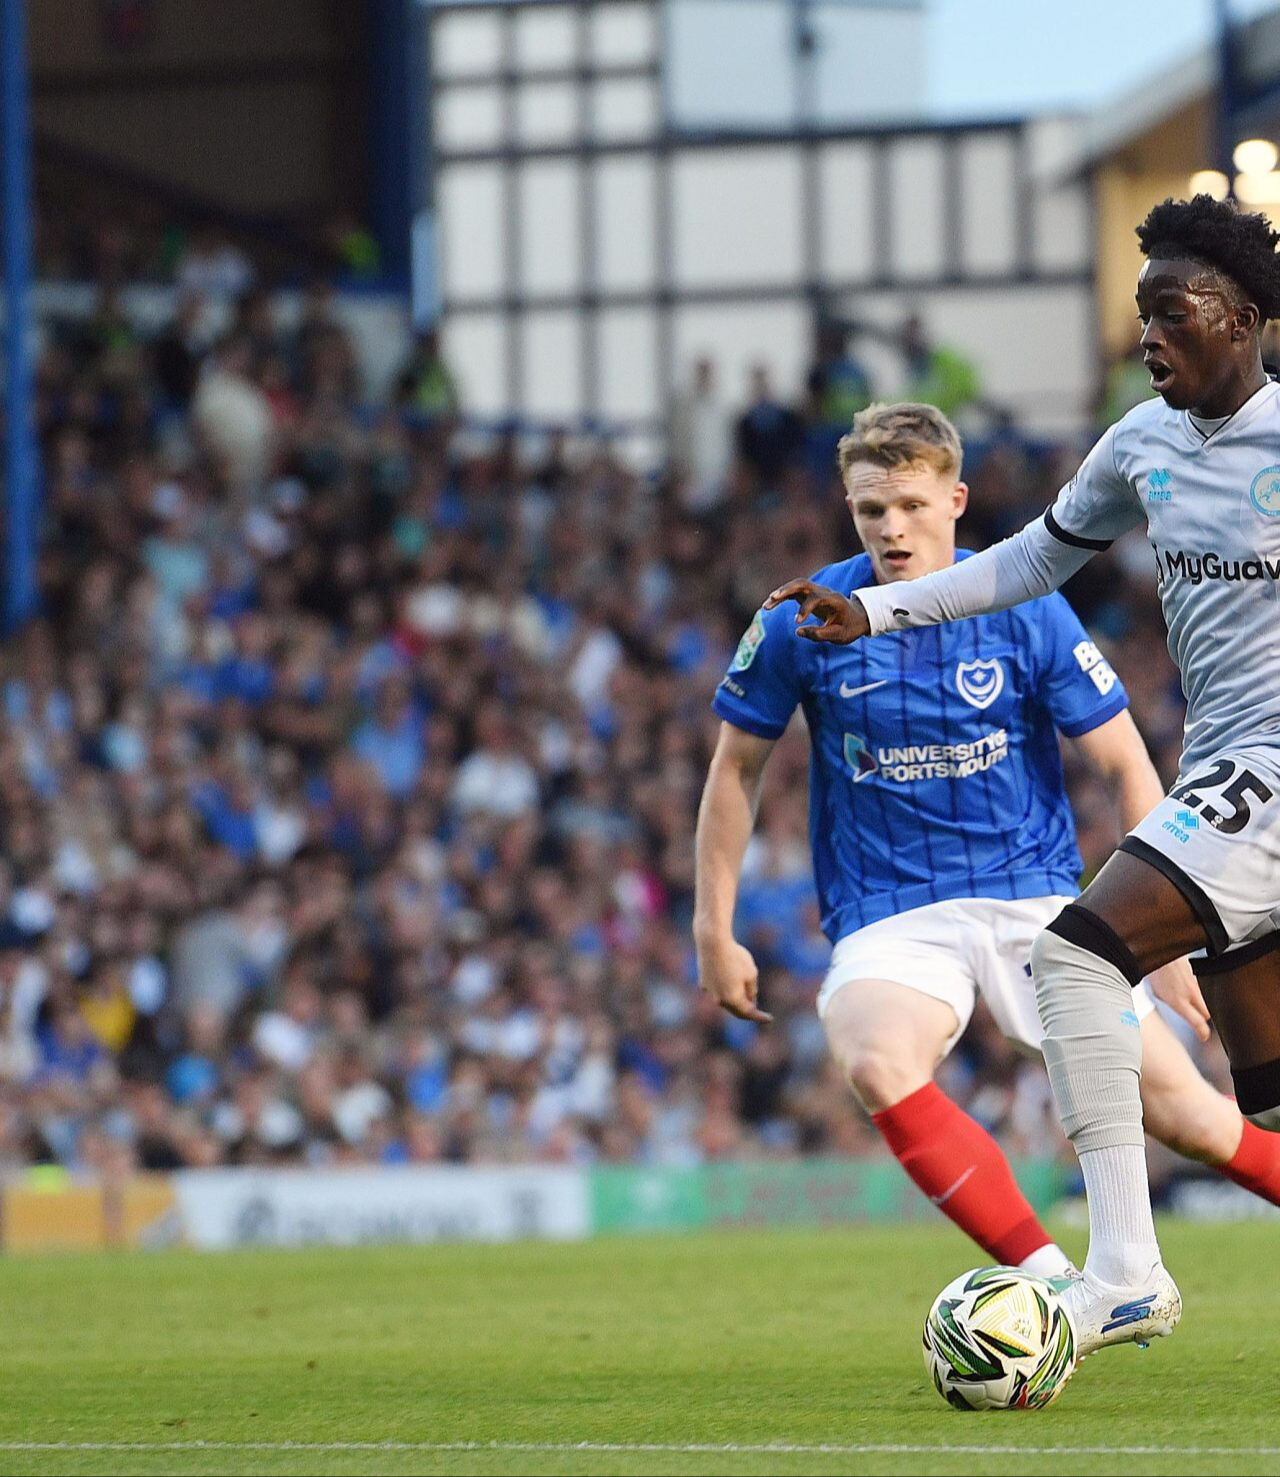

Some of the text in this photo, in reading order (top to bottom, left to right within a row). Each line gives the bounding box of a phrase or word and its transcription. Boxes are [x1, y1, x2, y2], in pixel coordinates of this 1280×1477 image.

[878, 733, 997, 765] UNIVERSITY
[881, 746, 1008, 782] PORTSMOUTH
[1169, 758, 1274, 834] 25
